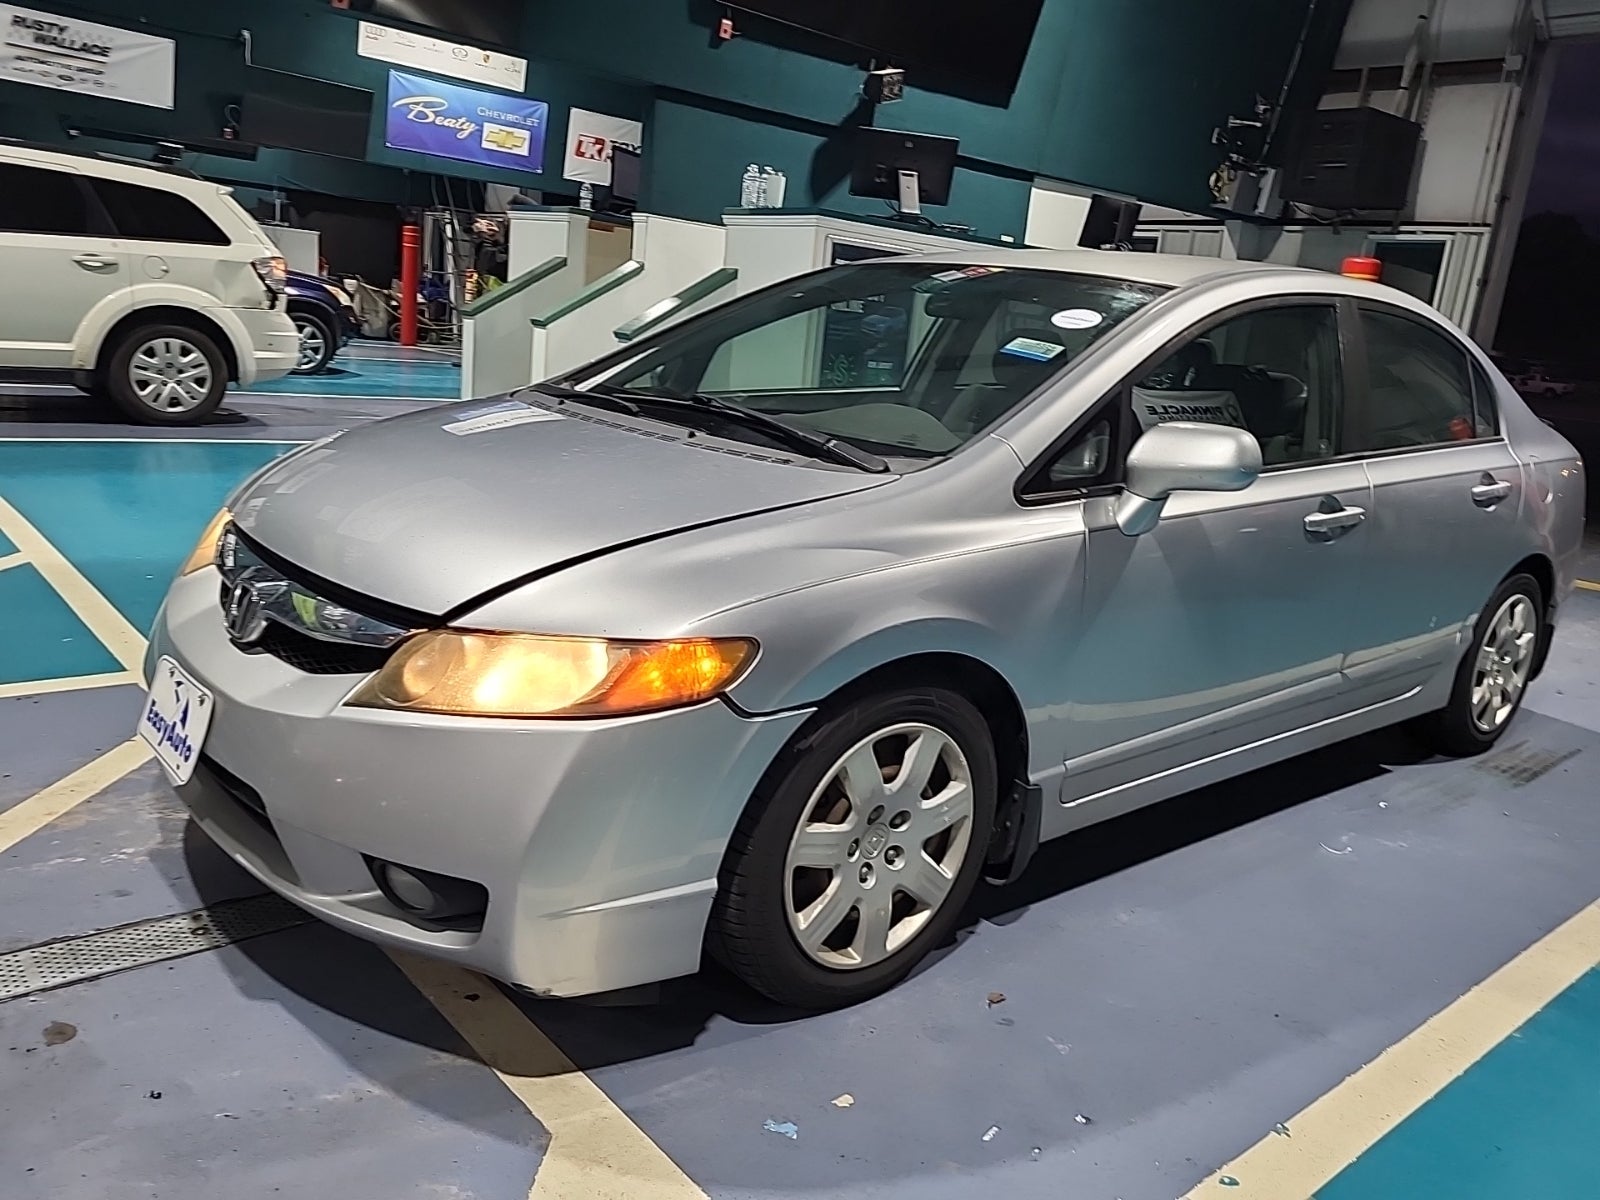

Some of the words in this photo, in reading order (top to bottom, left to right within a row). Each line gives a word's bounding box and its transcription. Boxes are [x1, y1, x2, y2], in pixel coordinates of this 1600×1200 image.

[11, 14, 69, 35] RUSTY
[34, 32, 112, 57] WALLACE
[392, 96, 480, 139] Beaty
[477, 106, 540, 127] CHEVROLET
